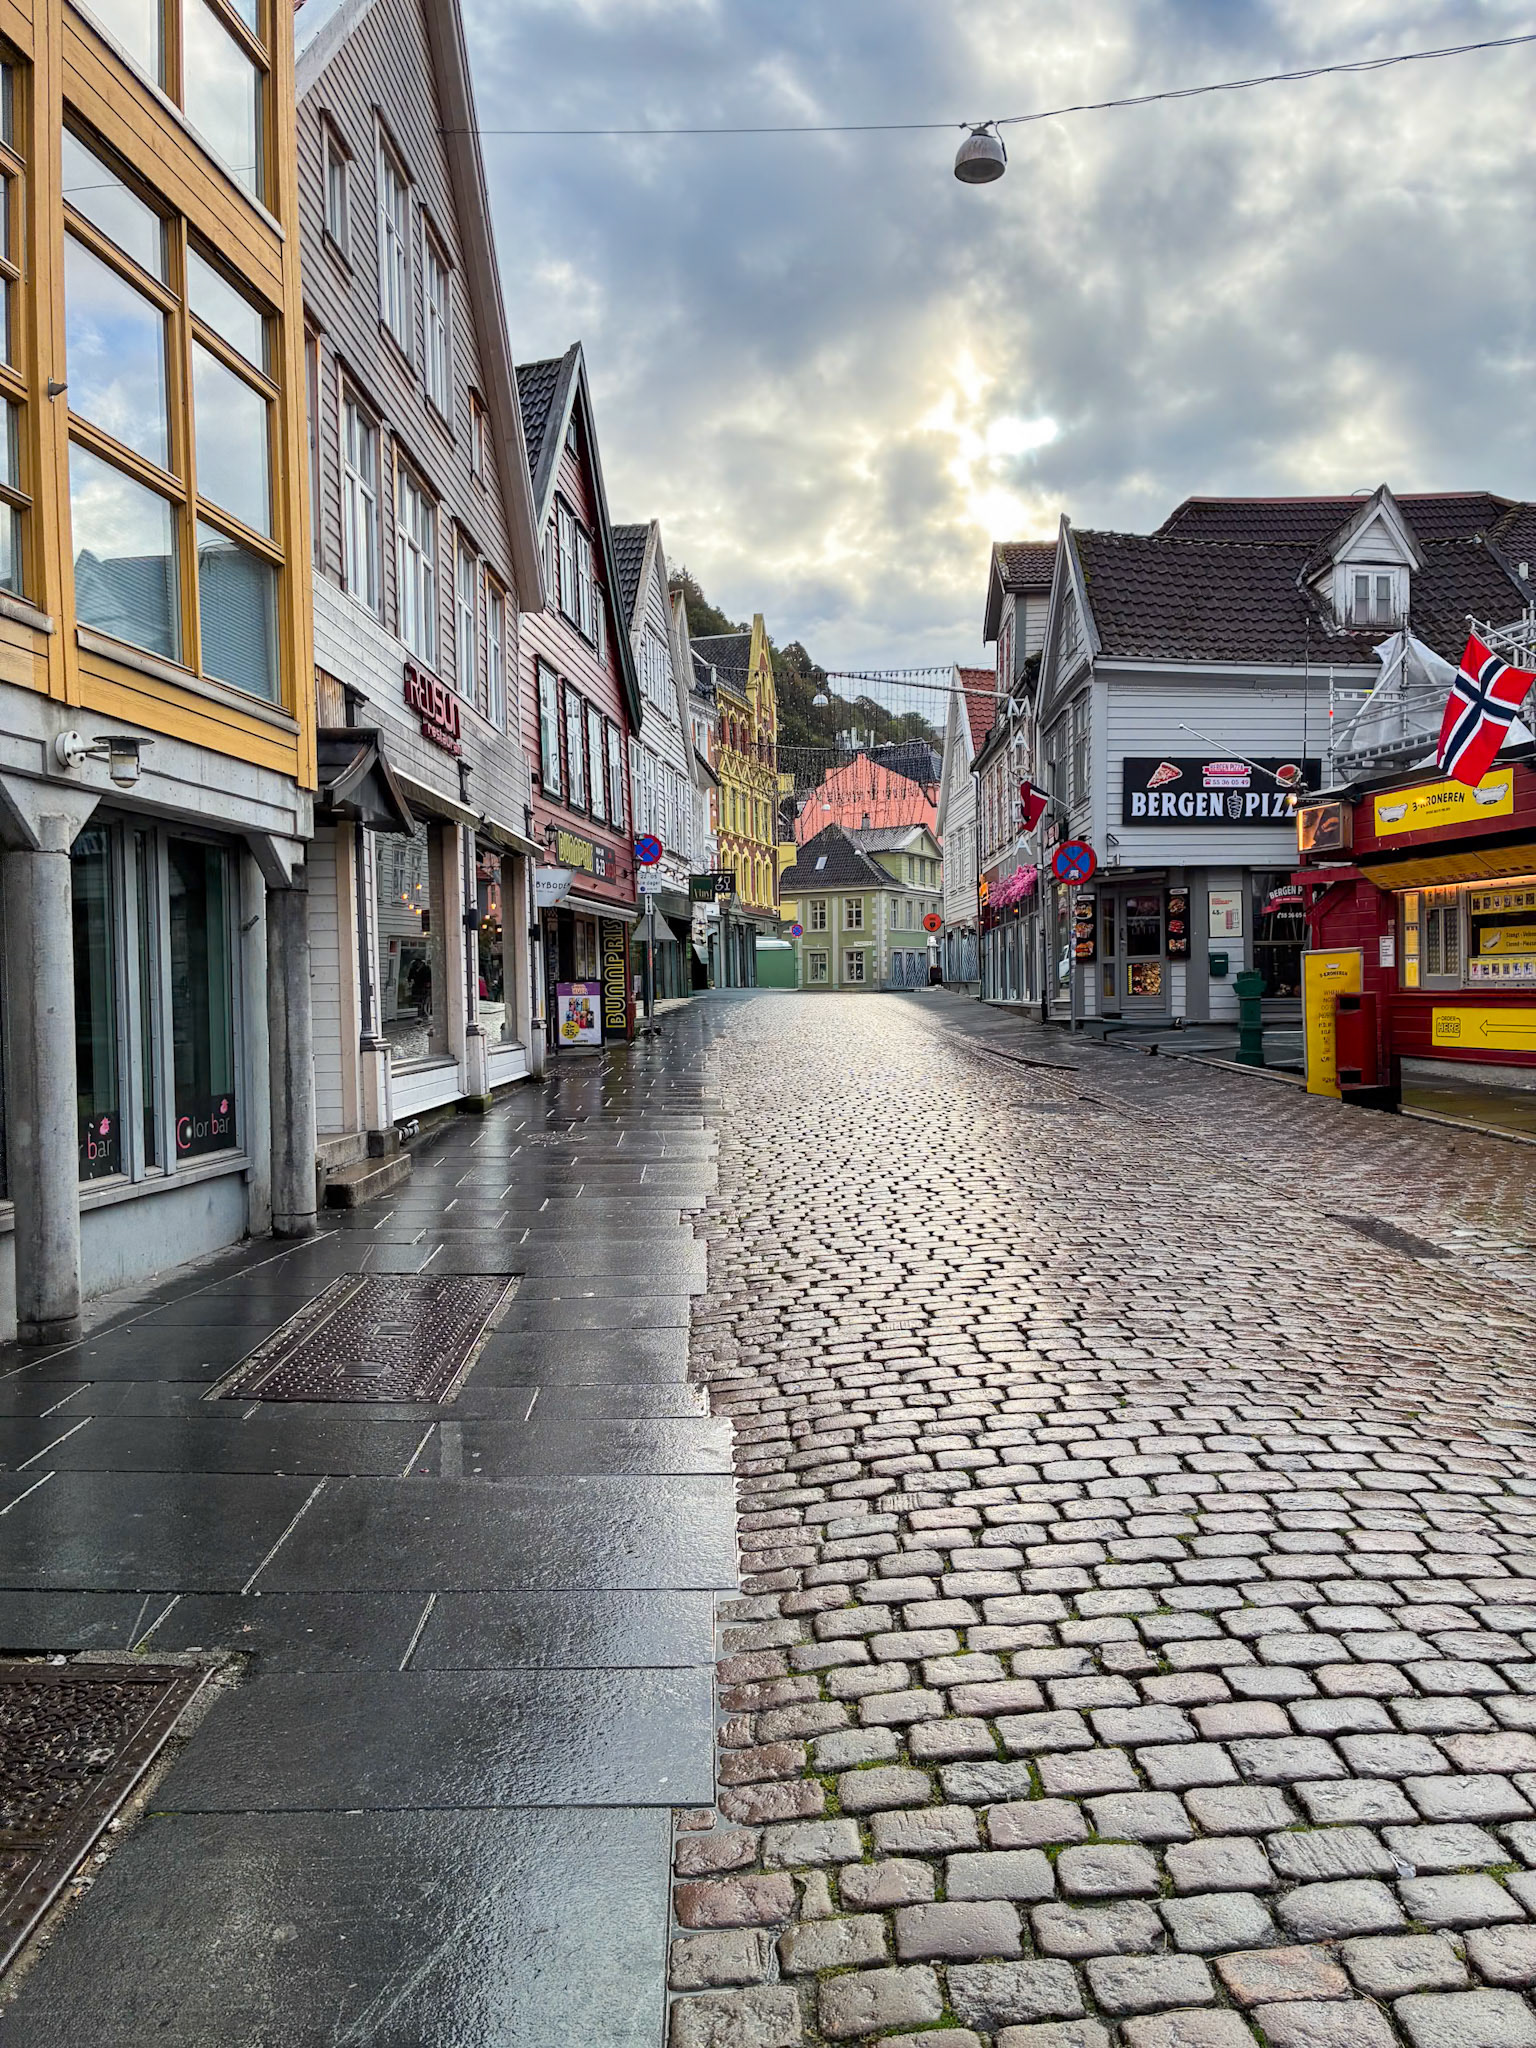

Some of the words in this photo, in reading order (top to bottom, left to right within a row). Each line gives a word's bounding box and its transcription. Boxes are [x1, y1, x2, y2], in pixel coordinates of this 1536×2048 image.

[1210, 763, 1229, 771] BERGEN
[1131, 792, 1224, 817] BERGEN
[1245, 792, 1298, 817] PIZZ
[1269, 886, 1297, 900] BERGEN
[603, 919, 627, 1028] BUNNPRIS
[1438, 1023, 1460, 1034] HERE
[211, 1113, 230, 1135] bar
[87, 1132, 112, 1160] bar
